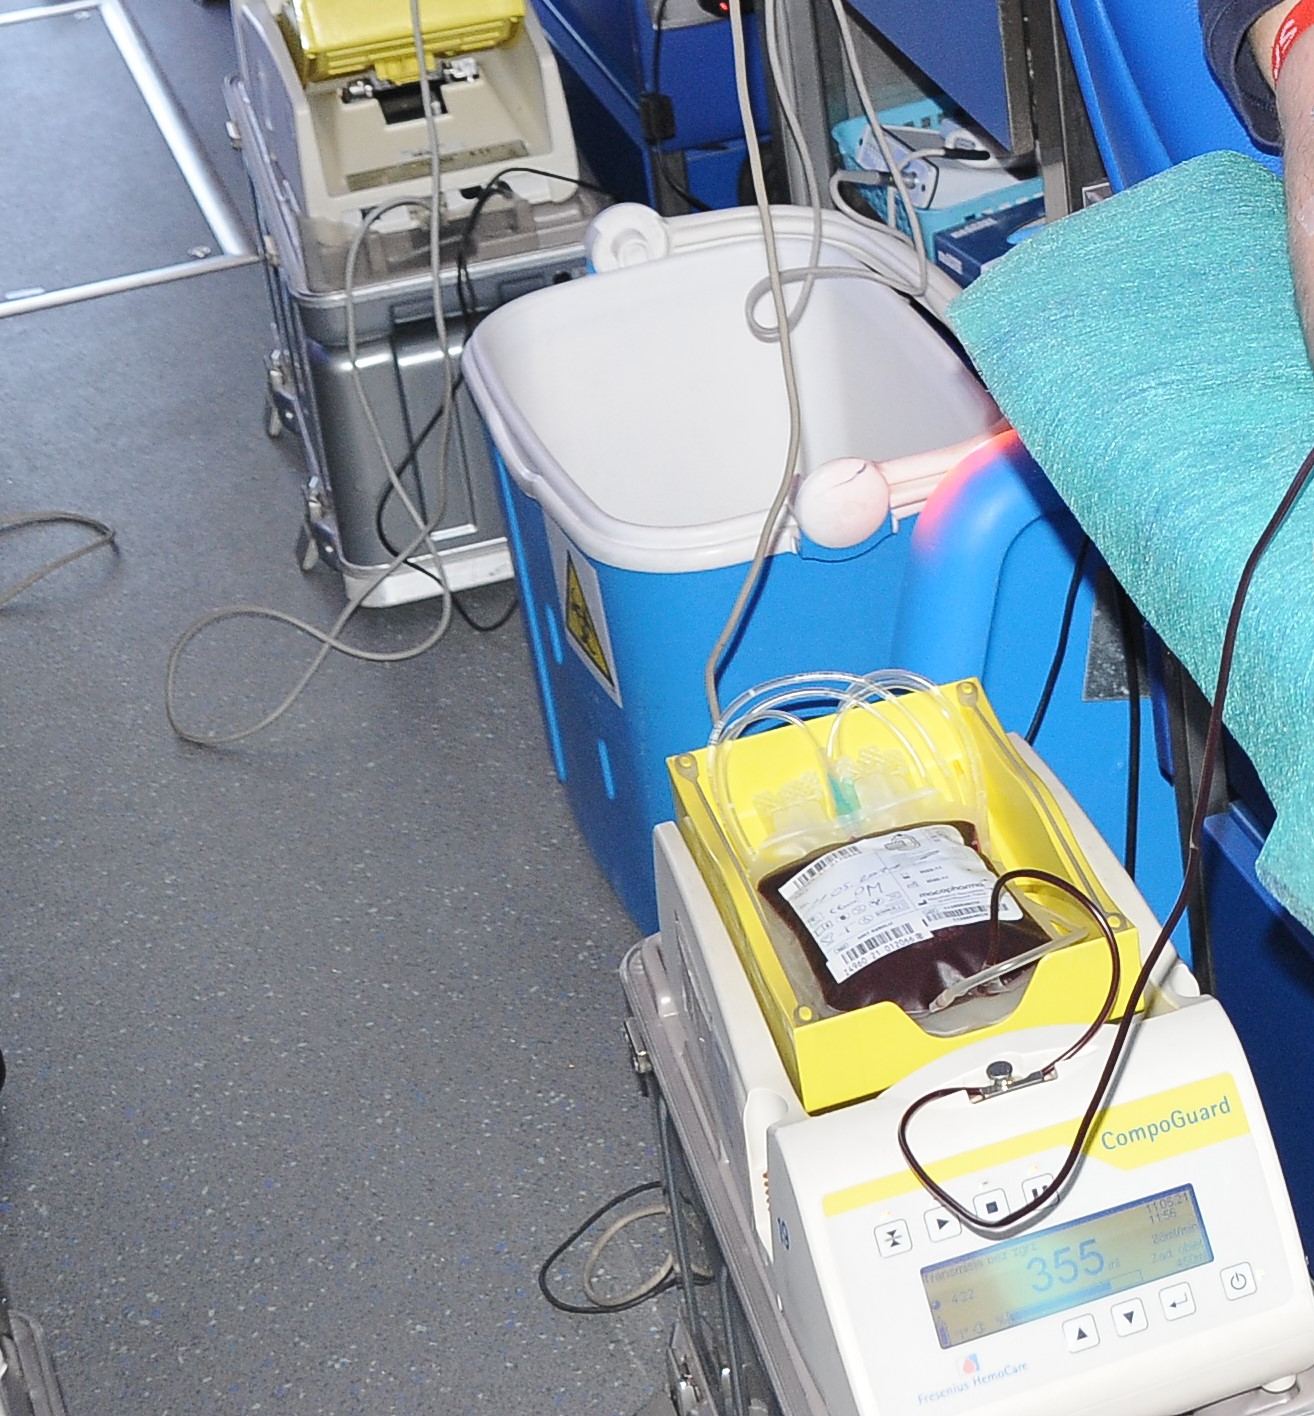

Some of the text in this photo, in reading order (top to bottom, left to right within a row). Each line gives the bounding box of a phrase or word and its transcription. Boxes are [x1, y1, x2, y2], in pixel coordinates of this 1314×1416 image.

[1101, 1095, 1231, 1150] CompoGuard
[1027, 1238, 1105, 1293] 355
[917, 1362, 1029, 1405] Fresenius HemoCare
